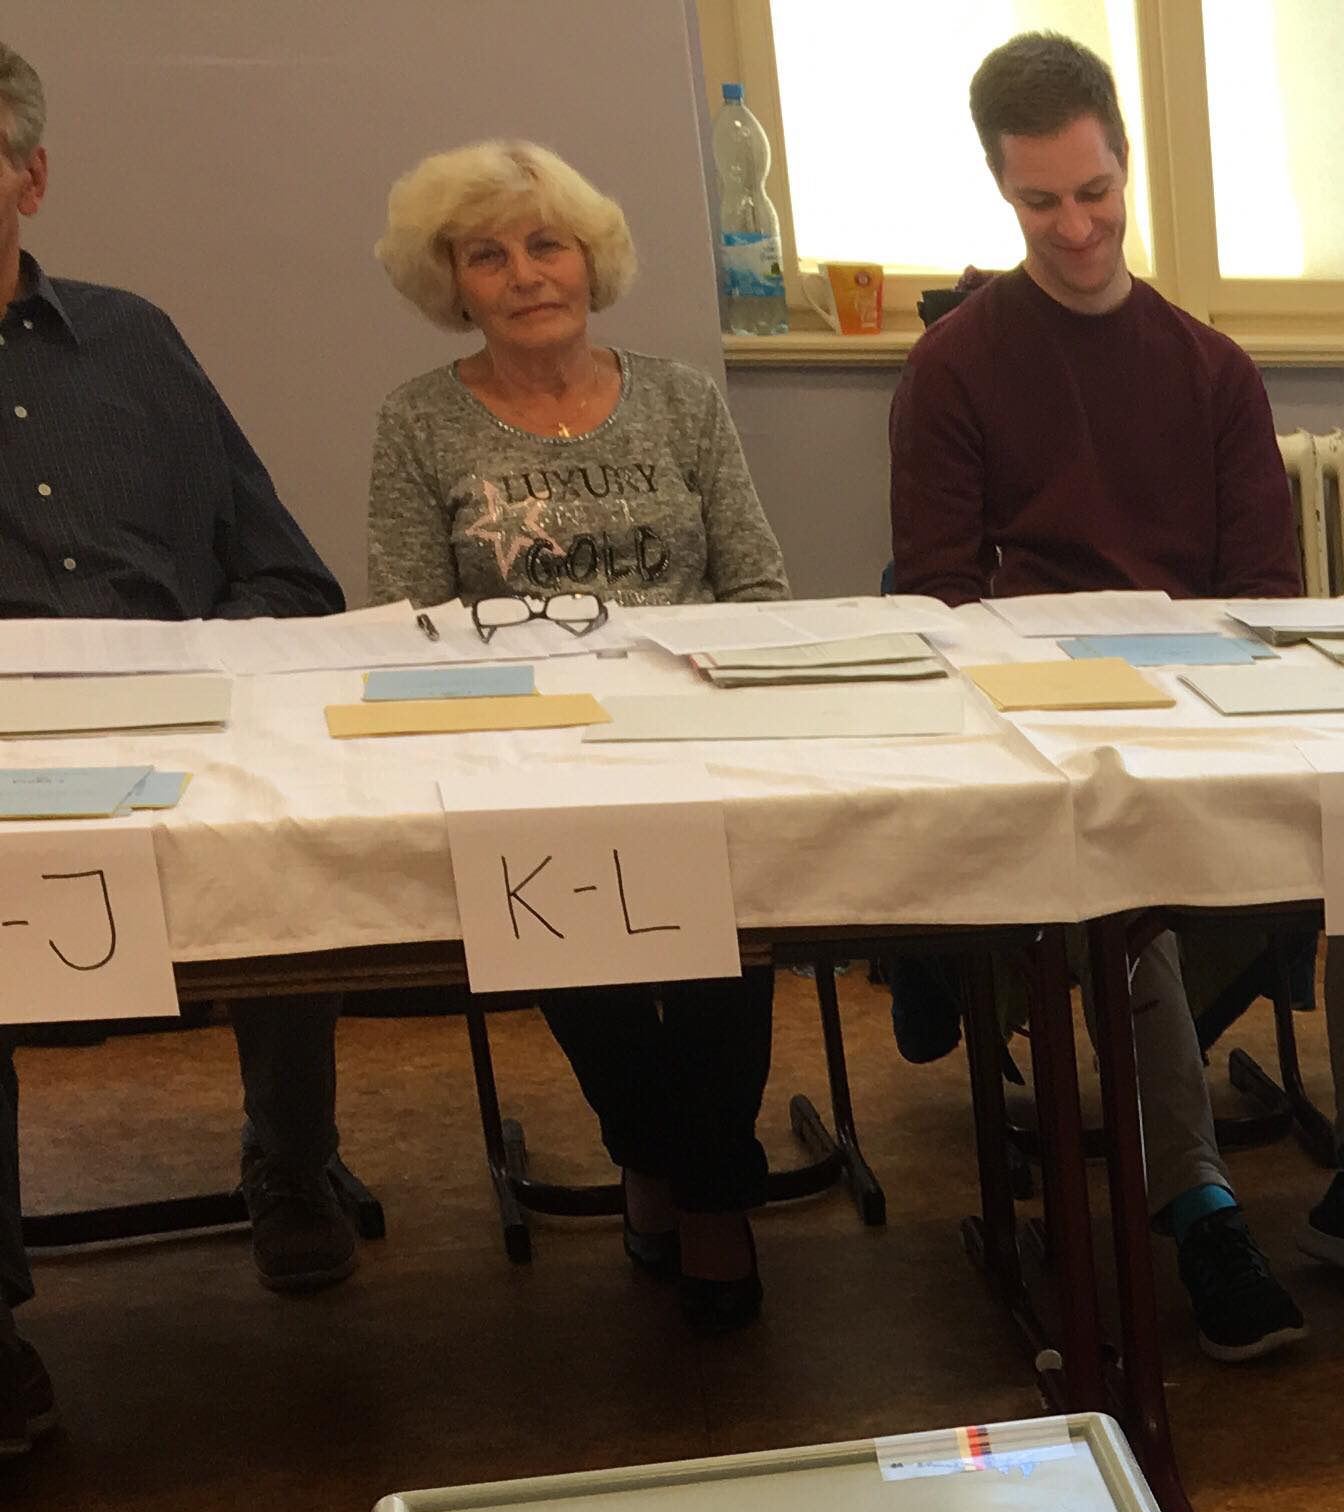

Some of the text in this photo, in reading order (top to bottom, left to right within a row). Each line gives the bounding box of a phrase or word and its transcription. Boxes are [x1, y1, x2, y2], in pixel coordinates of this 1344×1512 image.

[502, 463, 659, 501] LUXURY
[525, 525, 672, 590] GOLD
[500, 848, 682, 940] K-L
